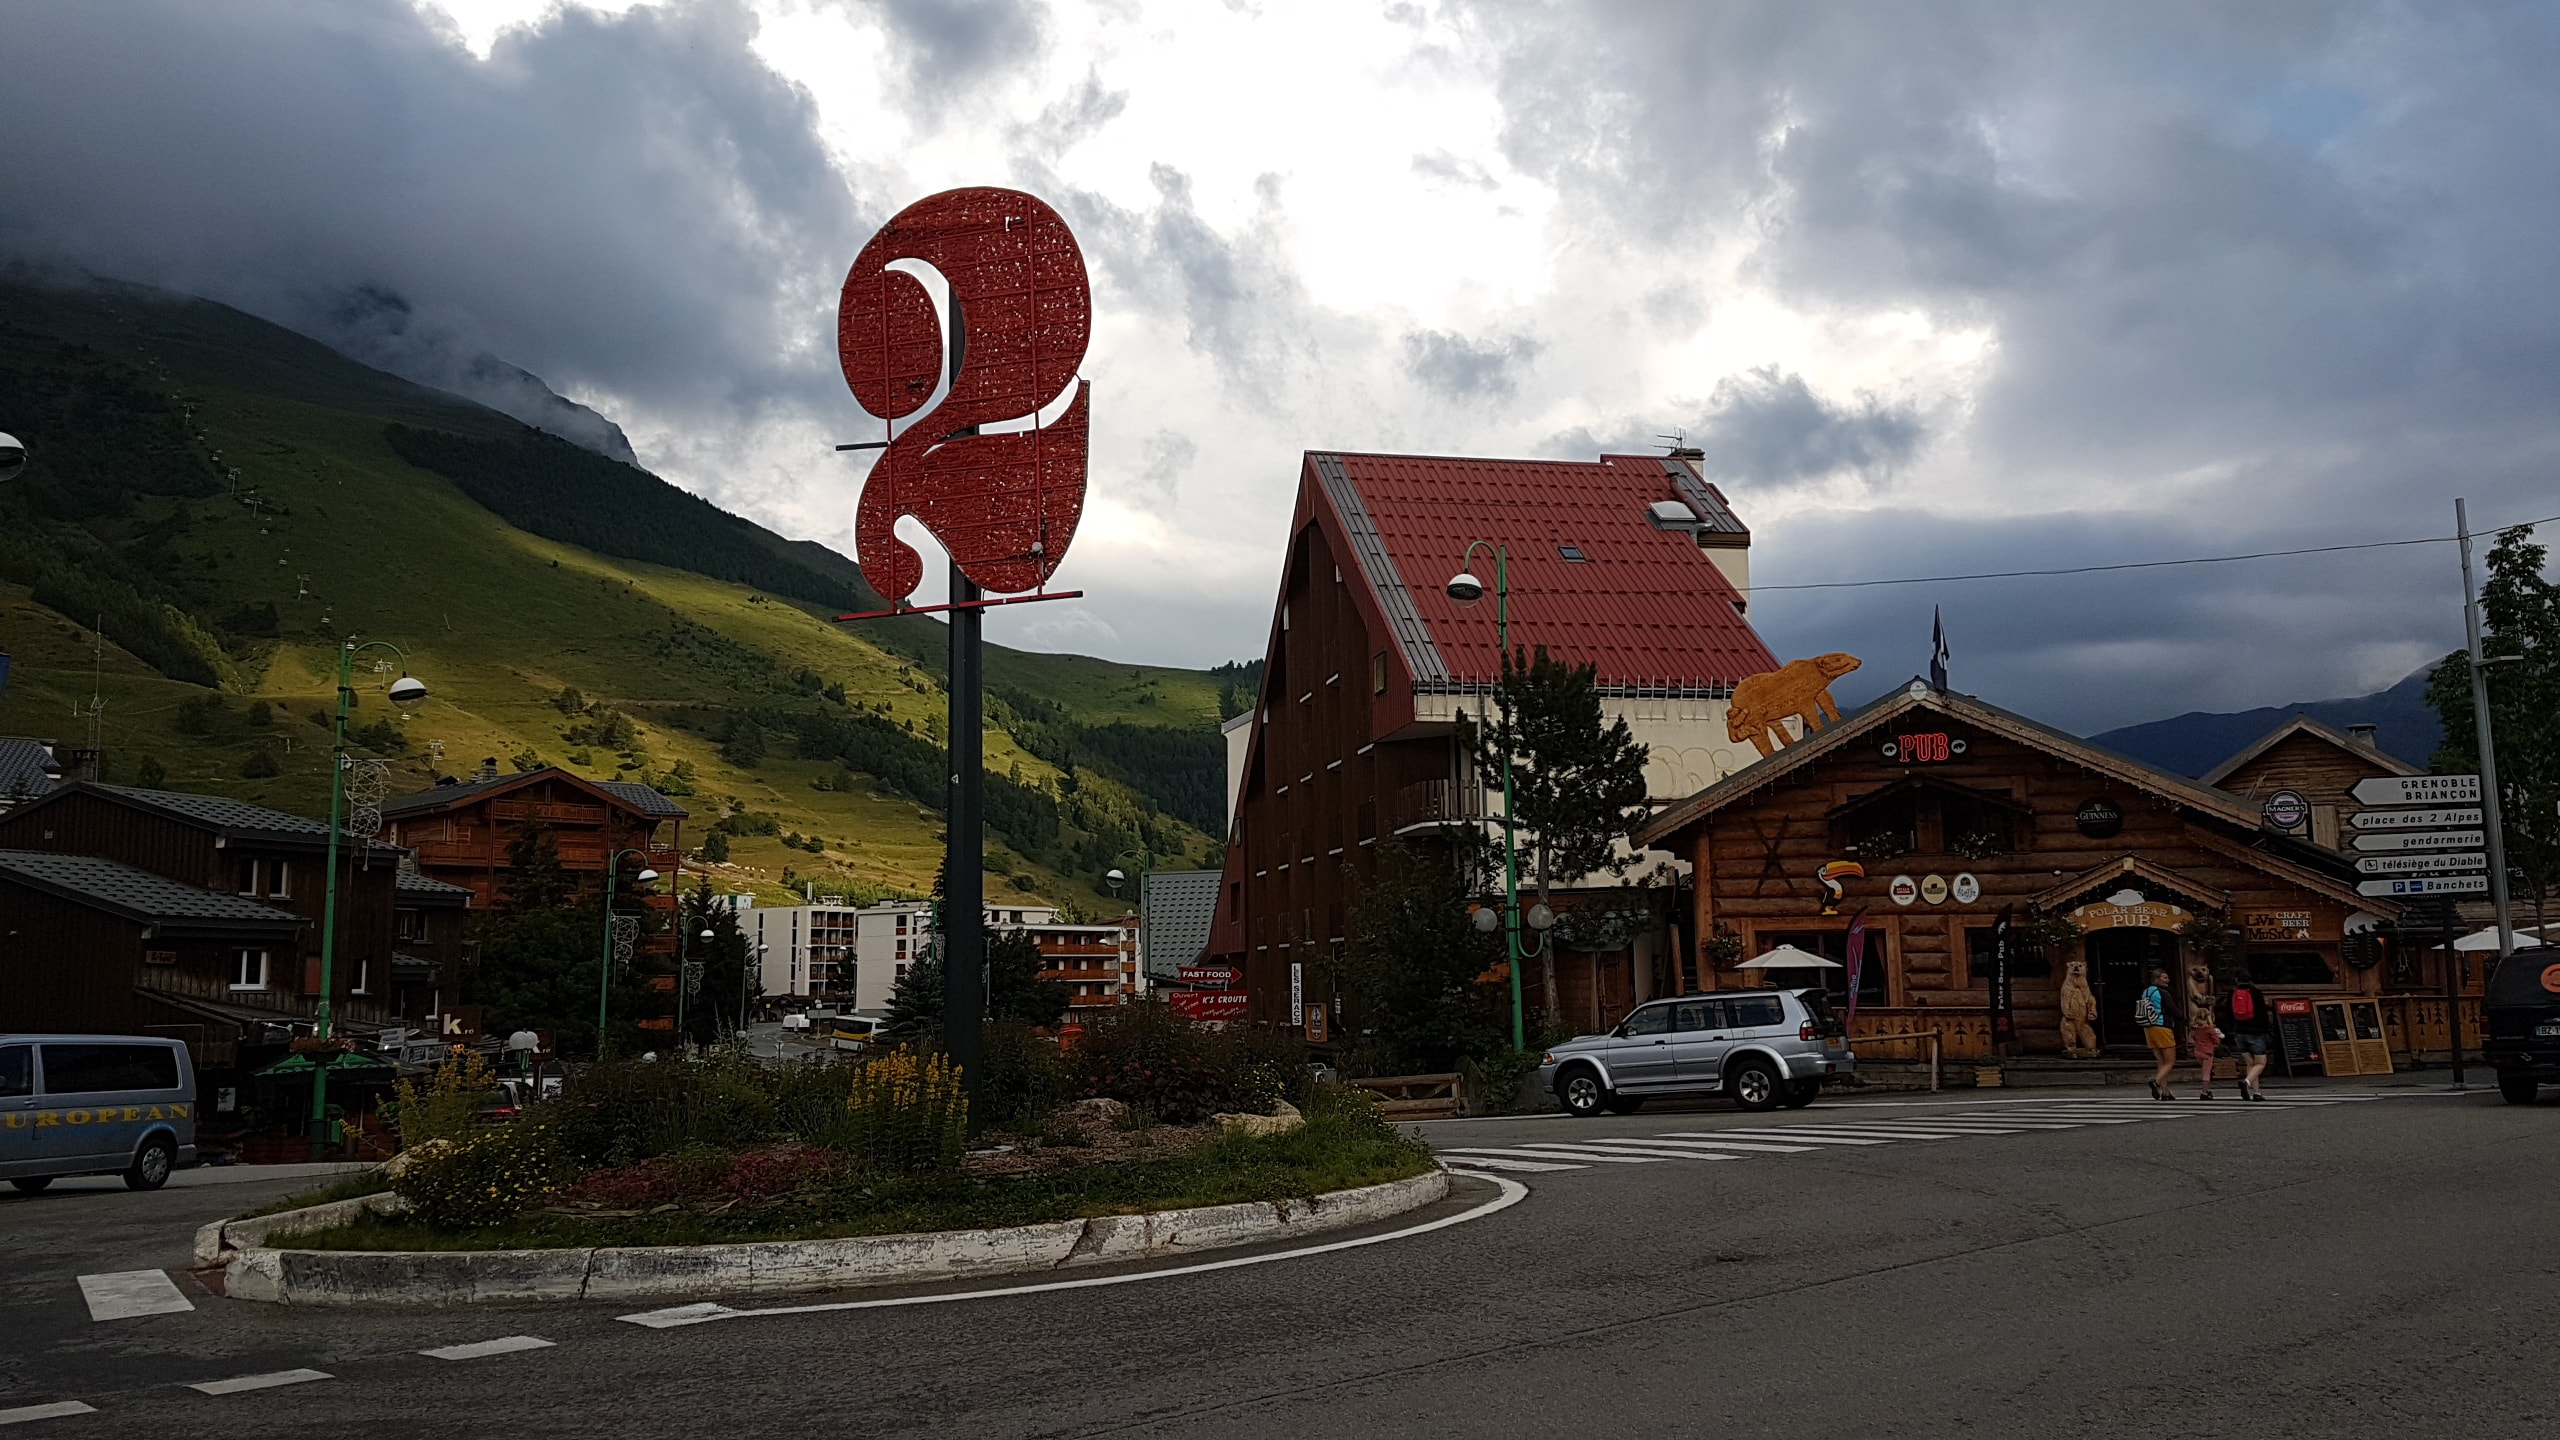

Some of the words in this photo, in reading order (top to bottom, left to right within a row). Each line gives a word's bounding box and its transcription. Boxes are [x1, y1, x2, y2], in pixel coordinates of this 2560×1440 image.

[1898, 733, 1949, 762] PUB
[2401, 777, 2477, 789] GRENOBLE
[2405, 789, 2477, 801] BRIANÇON
[2080, 811, 2118, 820] GUINNESS
[2362, 815, 2395, 827] place
[2402, 814, 2423, 824] des
[2430, 813, 2437, 823] 2
[2444, 812, 2479, 824] Alpes
[2402, 834, 2481, 847] gendarmerie
[2433, 857, 2446, 867] du
[2449, 856, 2483, 867] Diable
[2426, 880, 2485, 891] Banchets
[2089, 906, 2128, 919] POLAR
[2134, 906, 2168, 917] BEAR
[2276, 911, 2311, 919] CRAFT
[2112, 914, 2151, 926] PUB
[1218, 995, 1248, 1004] CROUTE
[2542, 1027, 2560, 1035] BZ-1
